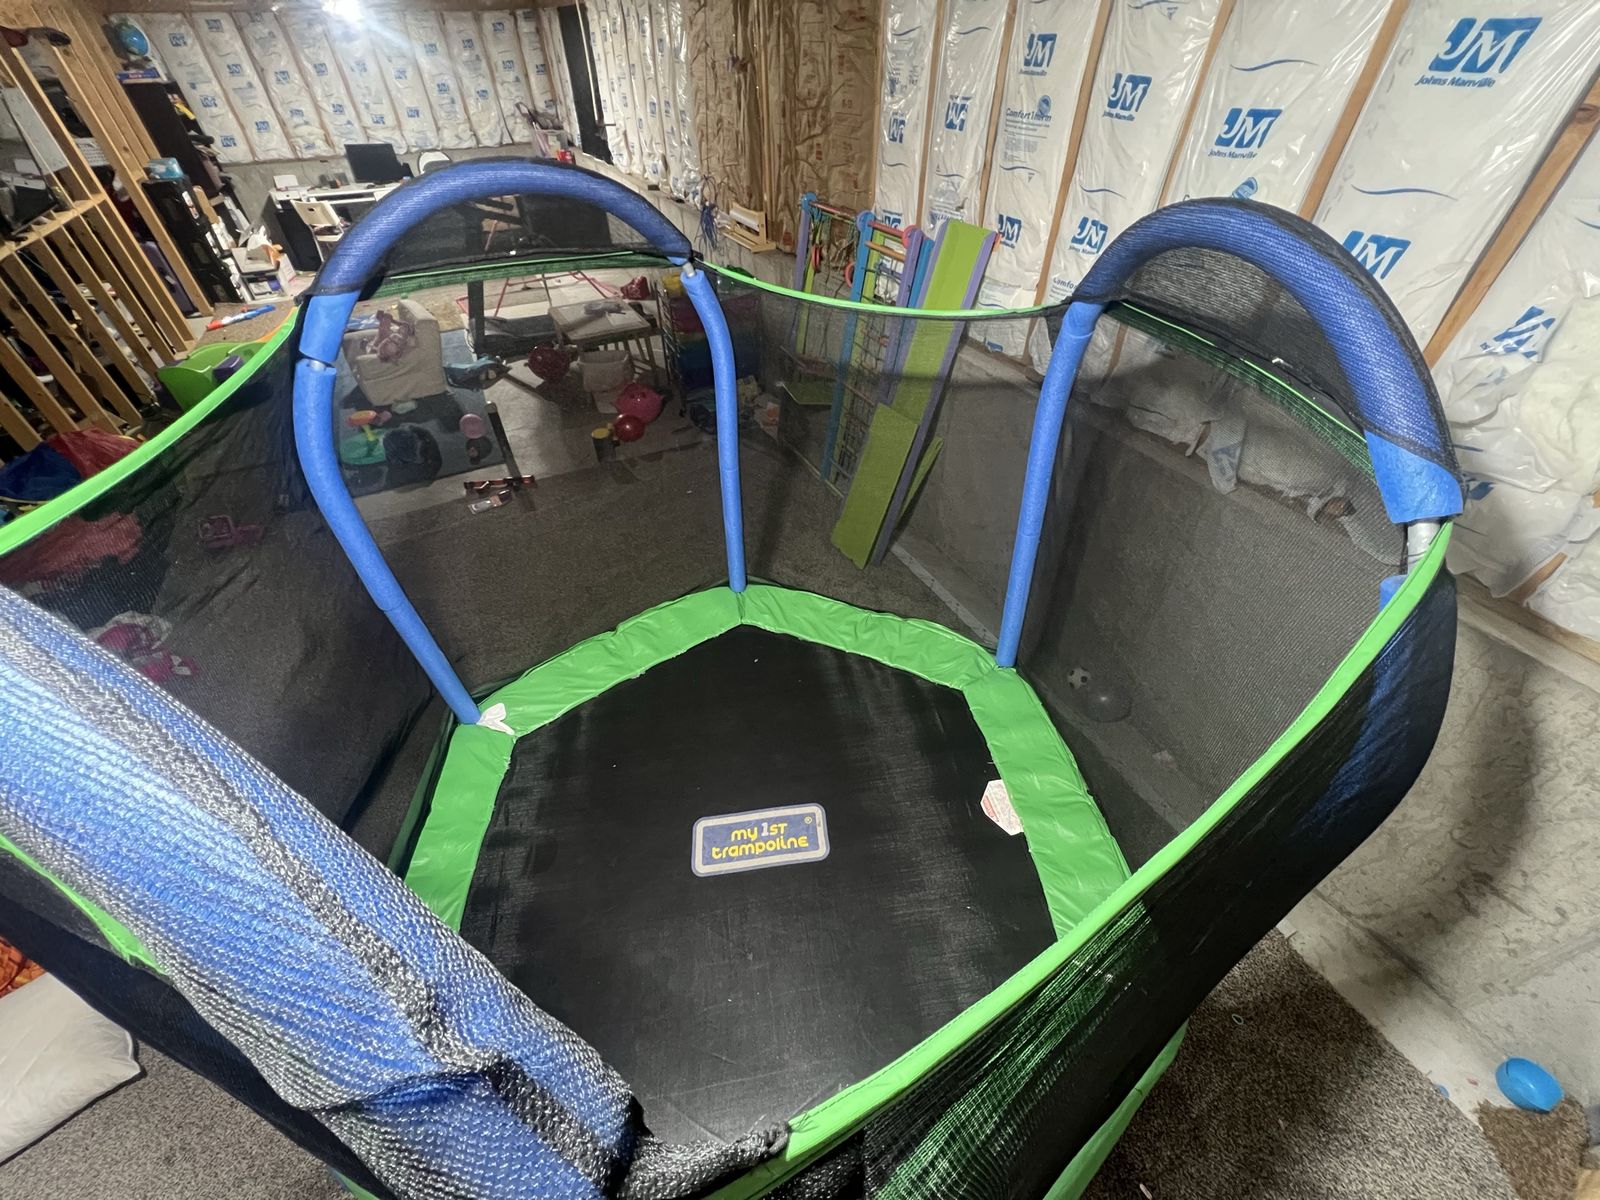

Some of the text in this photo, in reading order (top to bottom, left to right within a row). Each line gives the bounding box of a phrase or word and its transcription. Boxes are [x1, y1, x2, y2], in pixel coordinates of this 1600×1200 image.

[1023, 33, 1057, 68] JM
[1428, 17, 1543, 74] JM
[1106, 73, 1152, 112] JM
[1414, 74, 1496, 88] Johns Manville
[1214, 107, 1283, 149] JM
[711, 835, 809, 860] trampoline
[731, 826, 758, 842] my
